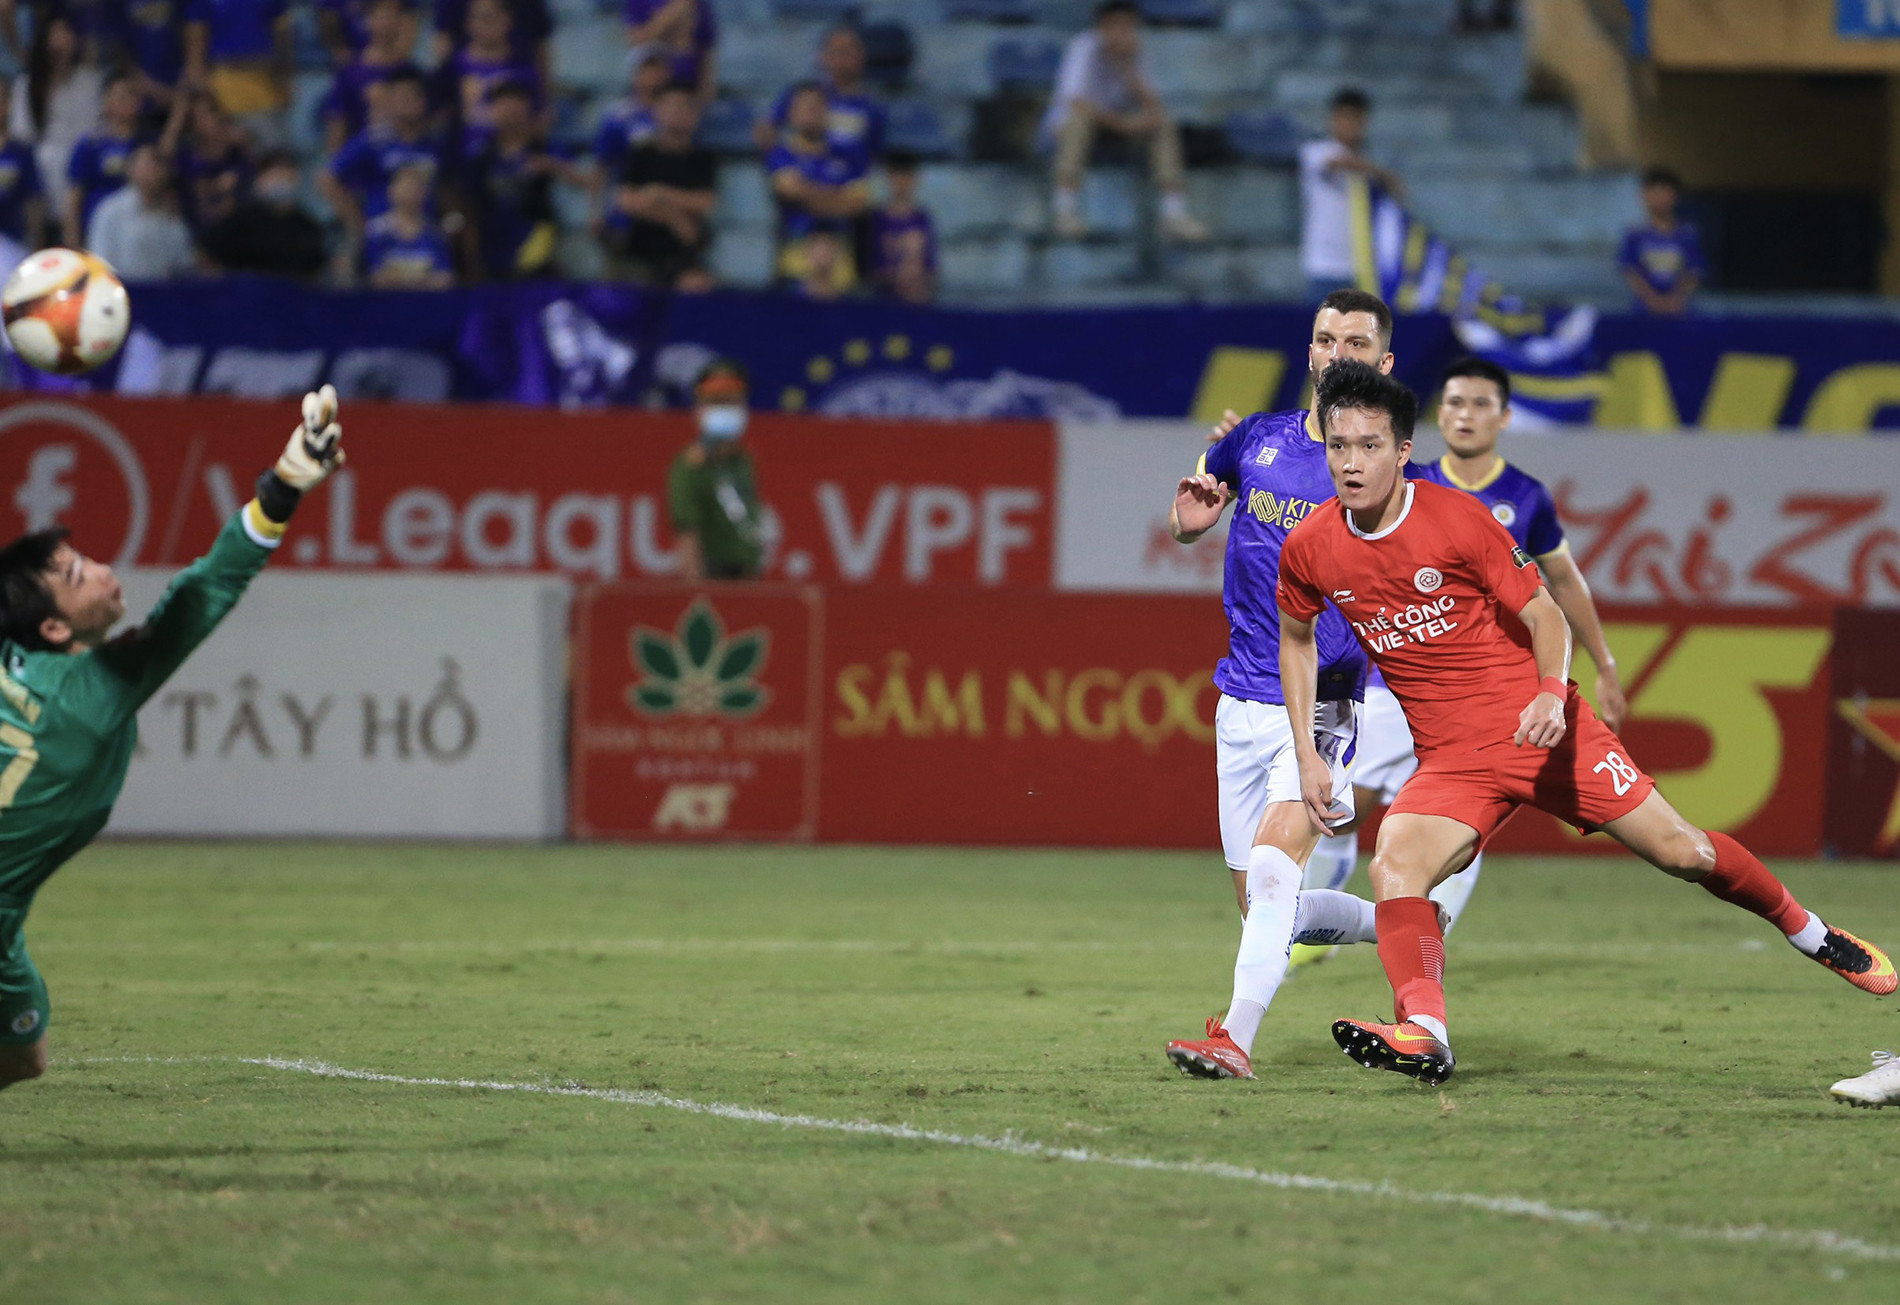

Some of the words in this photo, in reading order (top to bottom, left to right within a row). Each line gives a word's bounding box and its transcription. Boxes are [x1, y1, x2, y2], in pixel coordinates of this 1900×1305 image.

[1393, 595, 1456, 629] CÔNG
[160, 670, 337, 761] TÂY
[1592, 750, 1639, 797] 28
